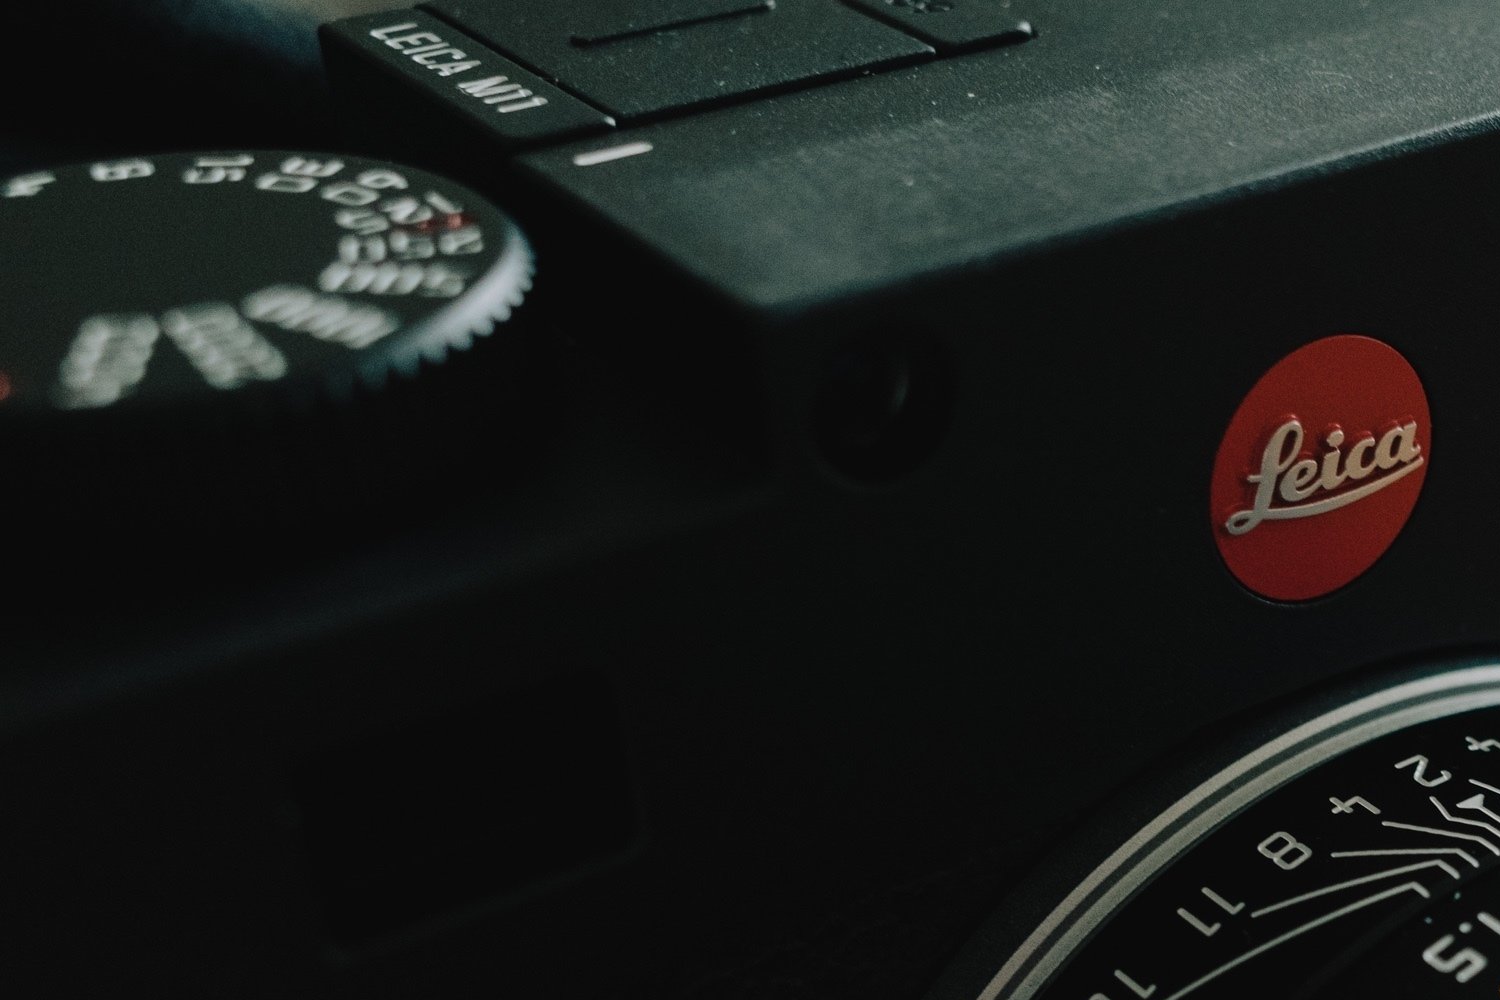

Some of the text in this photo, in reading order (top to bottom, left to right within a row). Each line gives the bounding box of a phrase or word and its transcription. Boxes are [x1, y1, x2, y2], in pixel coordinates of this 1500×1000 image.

[370, 22, 549, 113] LEICA M11
[1225, 420, 1424, 536] Leica
[1394, 754, 1453, 789] 2
[1329, 795, 1382, 816] 4
[1257, 831, 1314, 871] 8
[1176, 886, 1247, 938] 11
